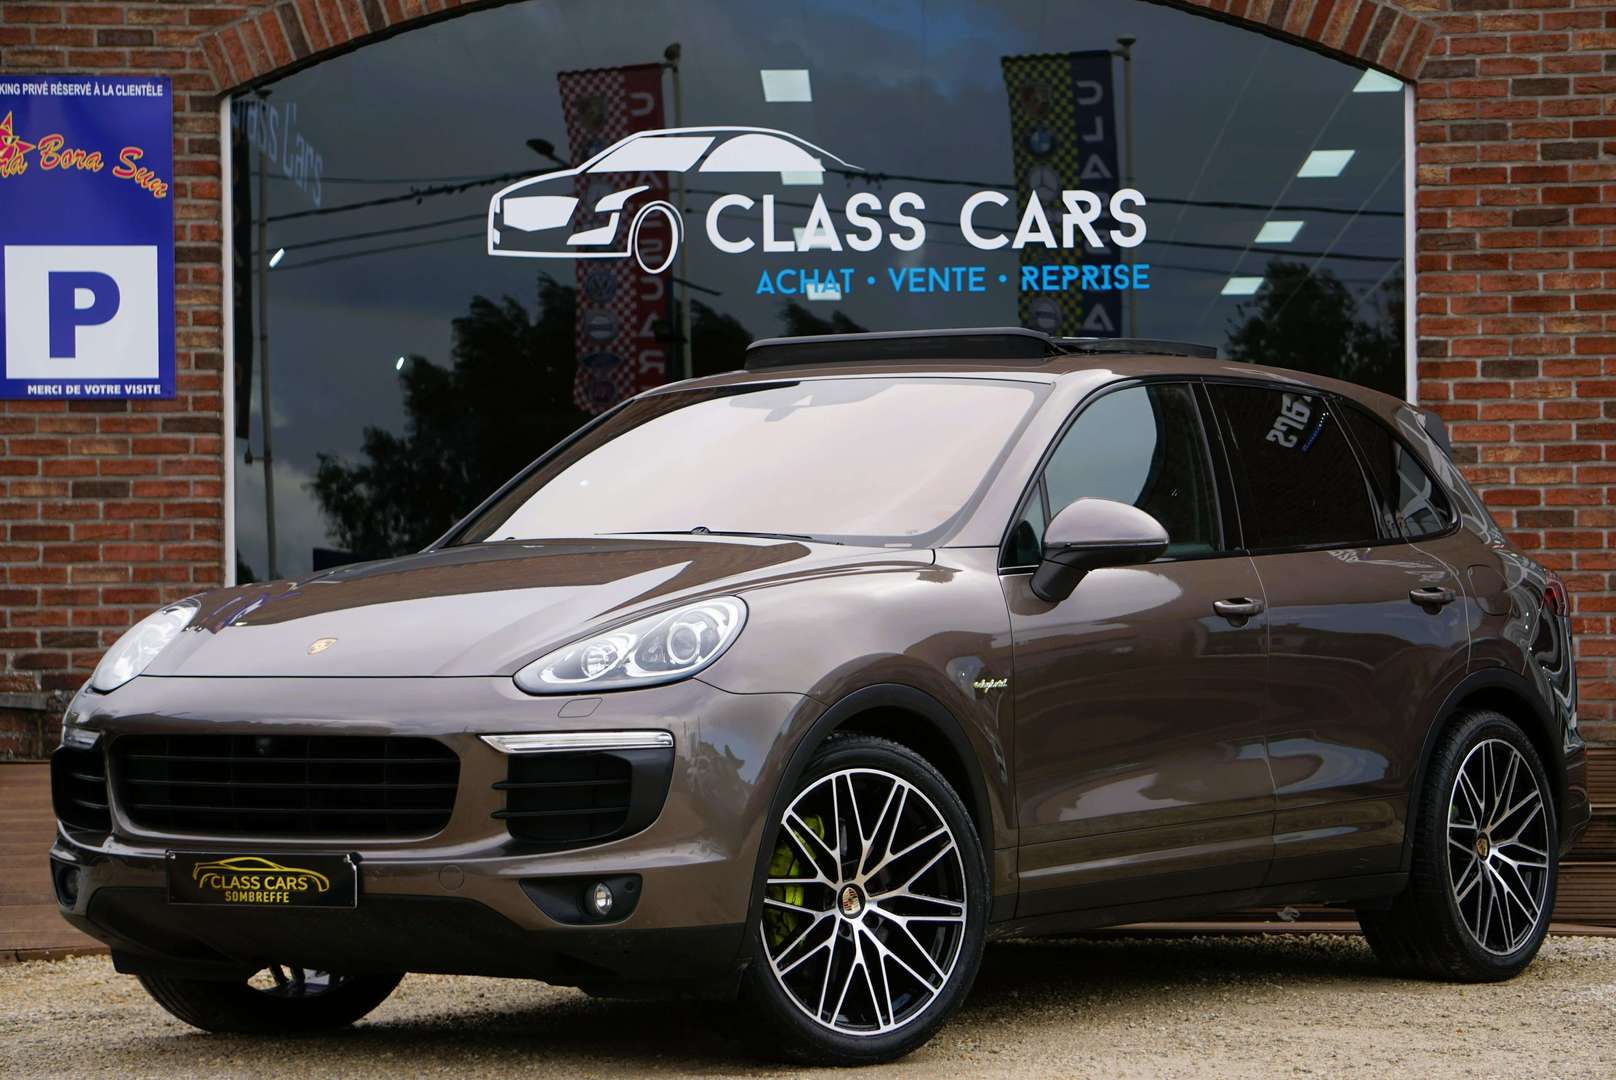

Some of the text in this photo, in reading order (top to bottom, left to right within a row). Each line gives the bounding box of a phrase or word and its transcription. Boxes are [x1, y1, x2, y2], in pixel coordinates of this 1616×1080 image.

[22, 80, 49, 95] PRIVÉ
[50, 80, 92, 95] RÉSERVÉ
[93, 81, 101, 96] À
[102, 84, 115, 96] LA
[38, 134, 104, 172] Bora
[112, 147, 168, 198] Sun
[705, 188, 1147, 254] CLASS CARS
[755, 263, 1150, 295] ACHAT VENTE REPRISE
[48, 271, 120, 358] P
[27, 384, 161, 395] MERCI DE VOTRE VISITE
[210, 875, 308, 891] CLASS CARS
[225, 890, 290, 903] SOMBREFFE
